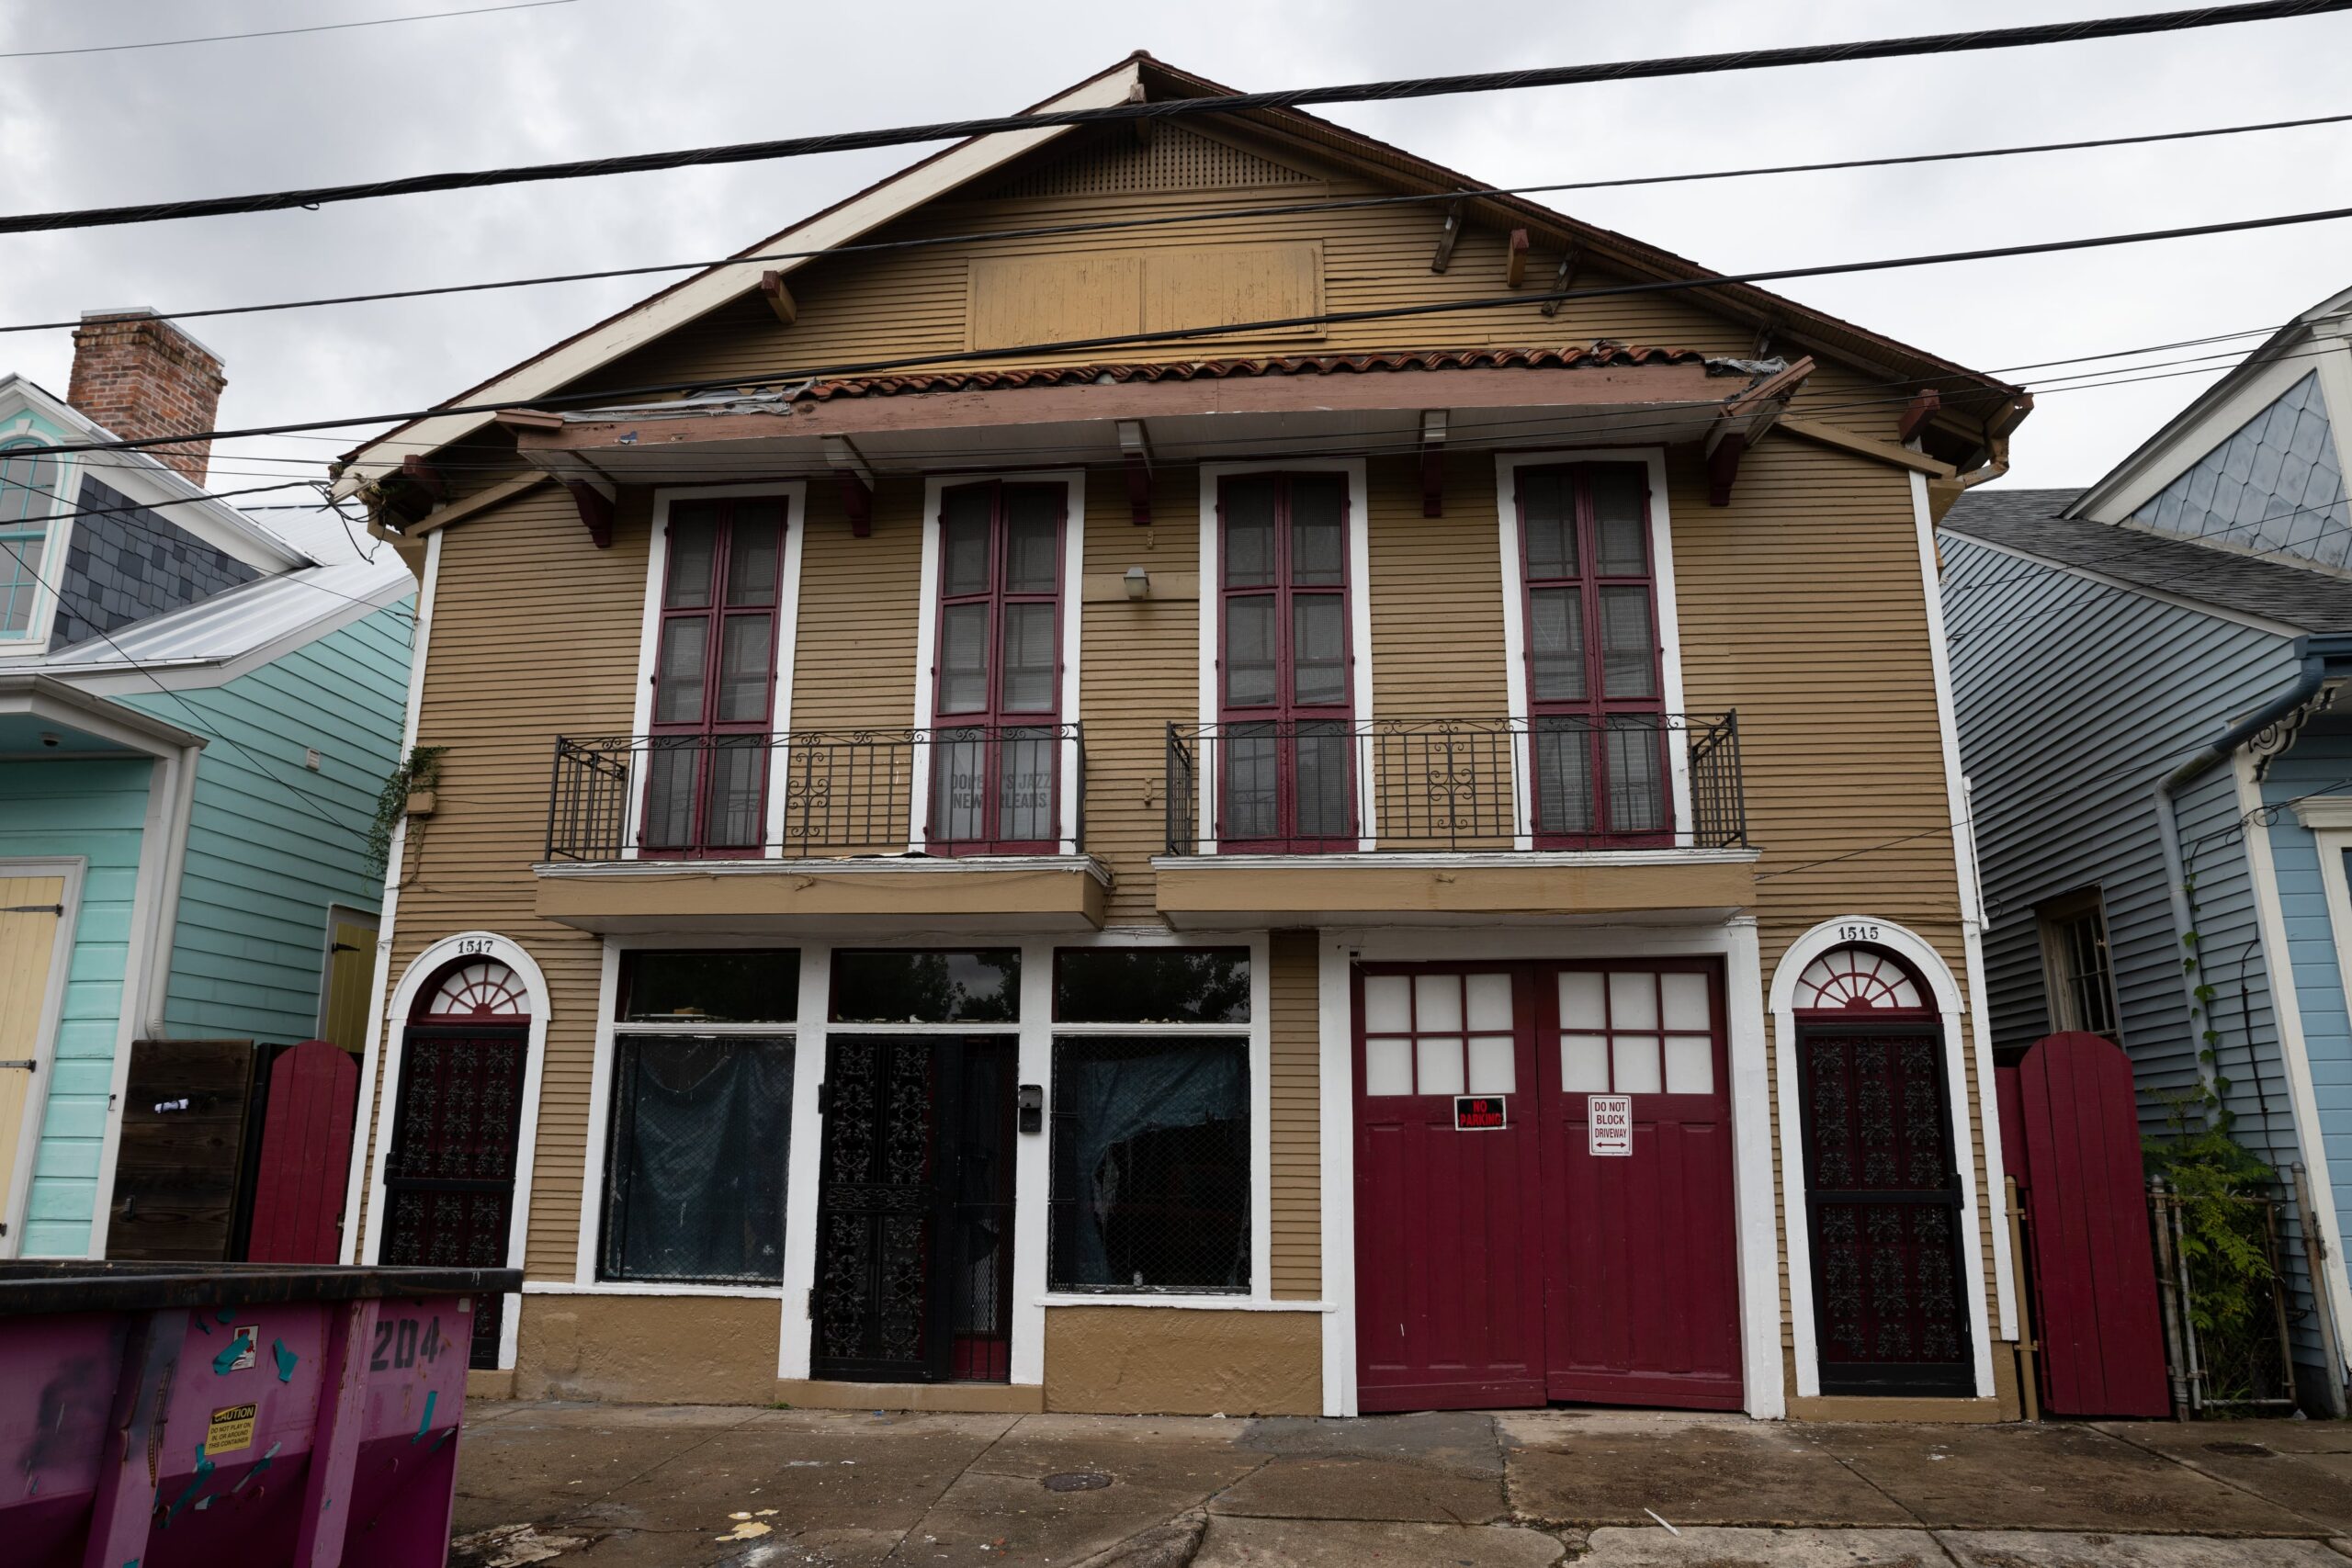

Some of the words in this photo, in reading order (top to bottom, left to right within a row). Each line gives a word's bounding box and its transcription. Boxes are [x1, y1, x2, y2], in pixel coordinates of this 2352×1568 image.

[1018, 773, 1051, 789] JAZZ
[953, 793, 984, 809] NEW
[1838, 927, 1879, 940] 1515
[458, 940, 493, 953] 1517
[1473, 1100, 1487, 1112] NO
[1594, 1101, 1607, 1112] DO
[1609, 1101, 1626, 1112] NOT
[1460, 1113, 1501, 1126] PARKING
[1596, 1114, 1625, 1125] BLOCK
[1594, 1128, 1627, 1139] DRIVEWAY
[369, 1315, 439, 1372] 204
